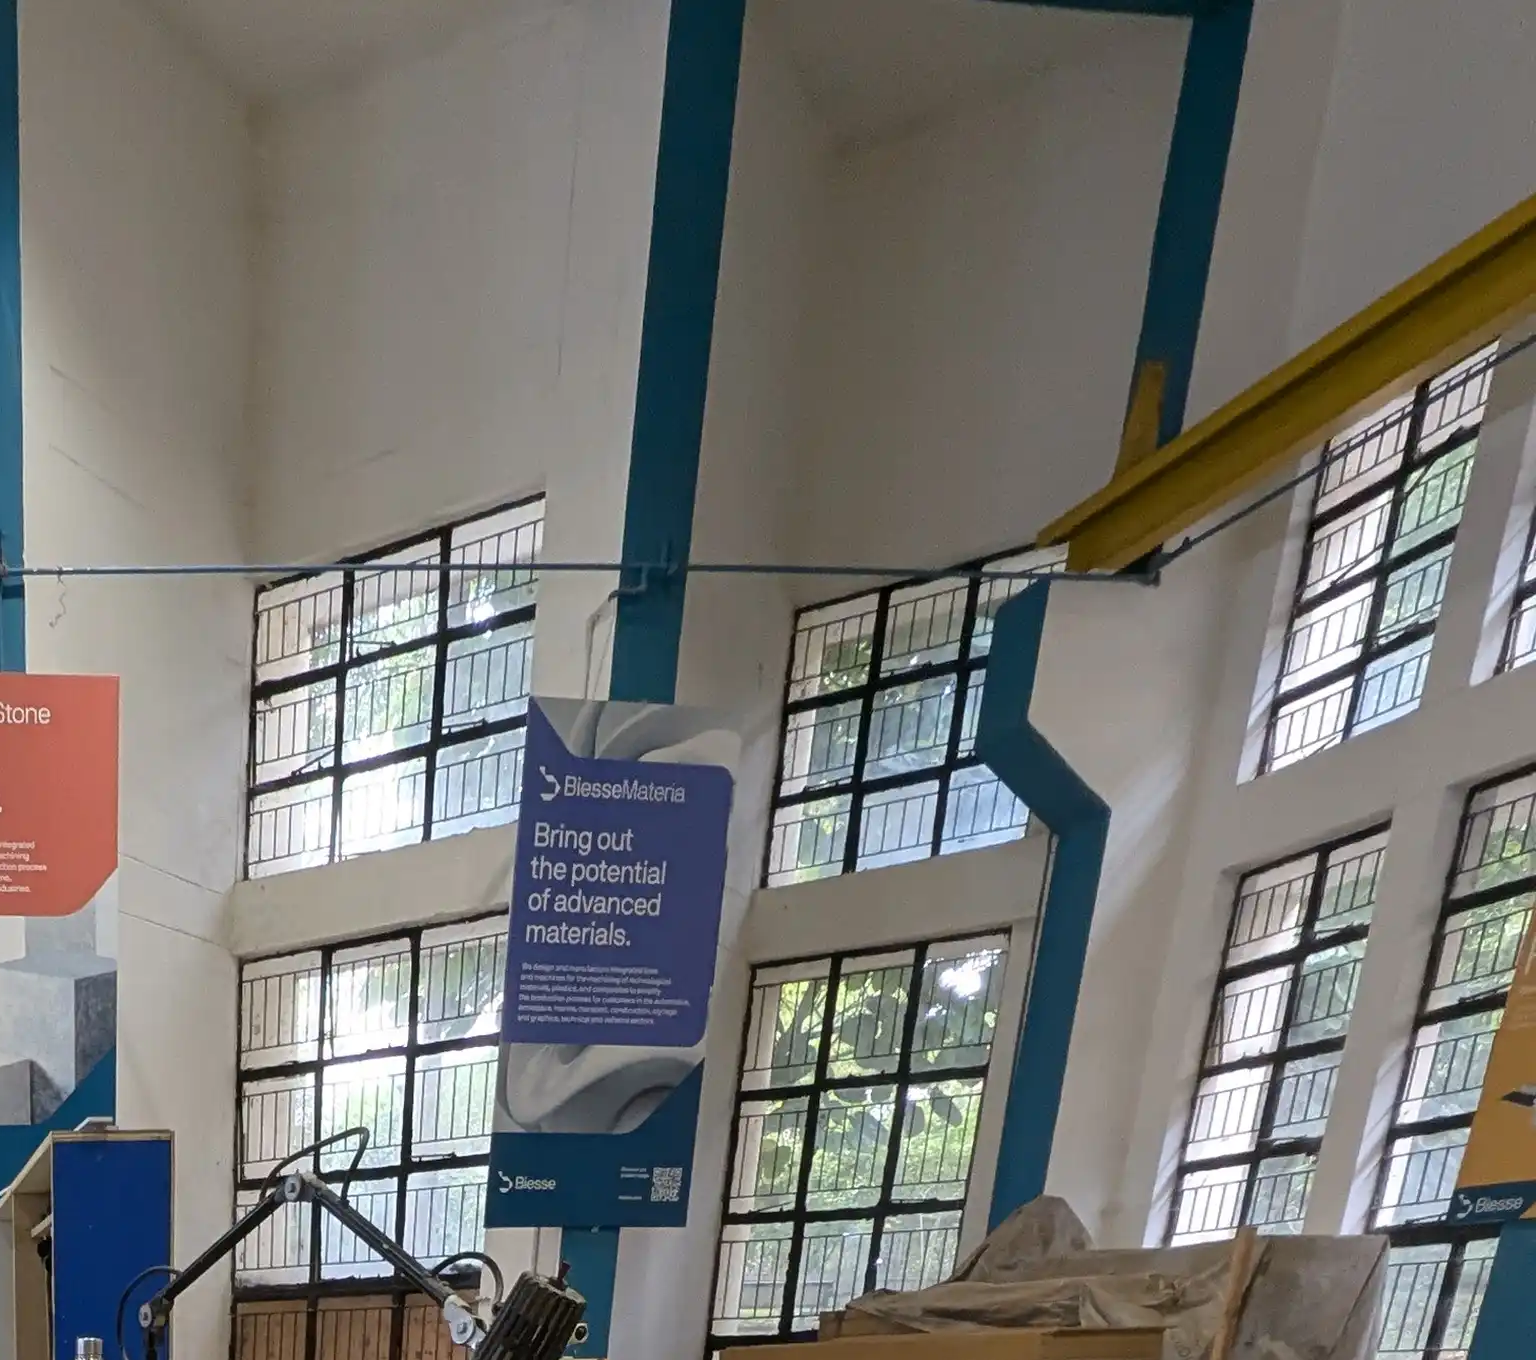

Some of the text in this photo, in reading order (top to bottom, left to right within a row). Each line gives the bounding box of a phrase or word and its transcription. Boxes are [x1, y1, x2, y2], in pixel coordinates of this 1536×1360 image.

[563, 774, 686, 804] BiesseMateria
[533, 821, 634, 856] Bring out
[529, 855, 668, 887] the potential
[527, 887, 662, 917] of advanced
[524, 921, 631, 947] materials.
[514, 1176, 557, 1190] Biesse
[1475, 1196, 1523, 1214] Biesse
